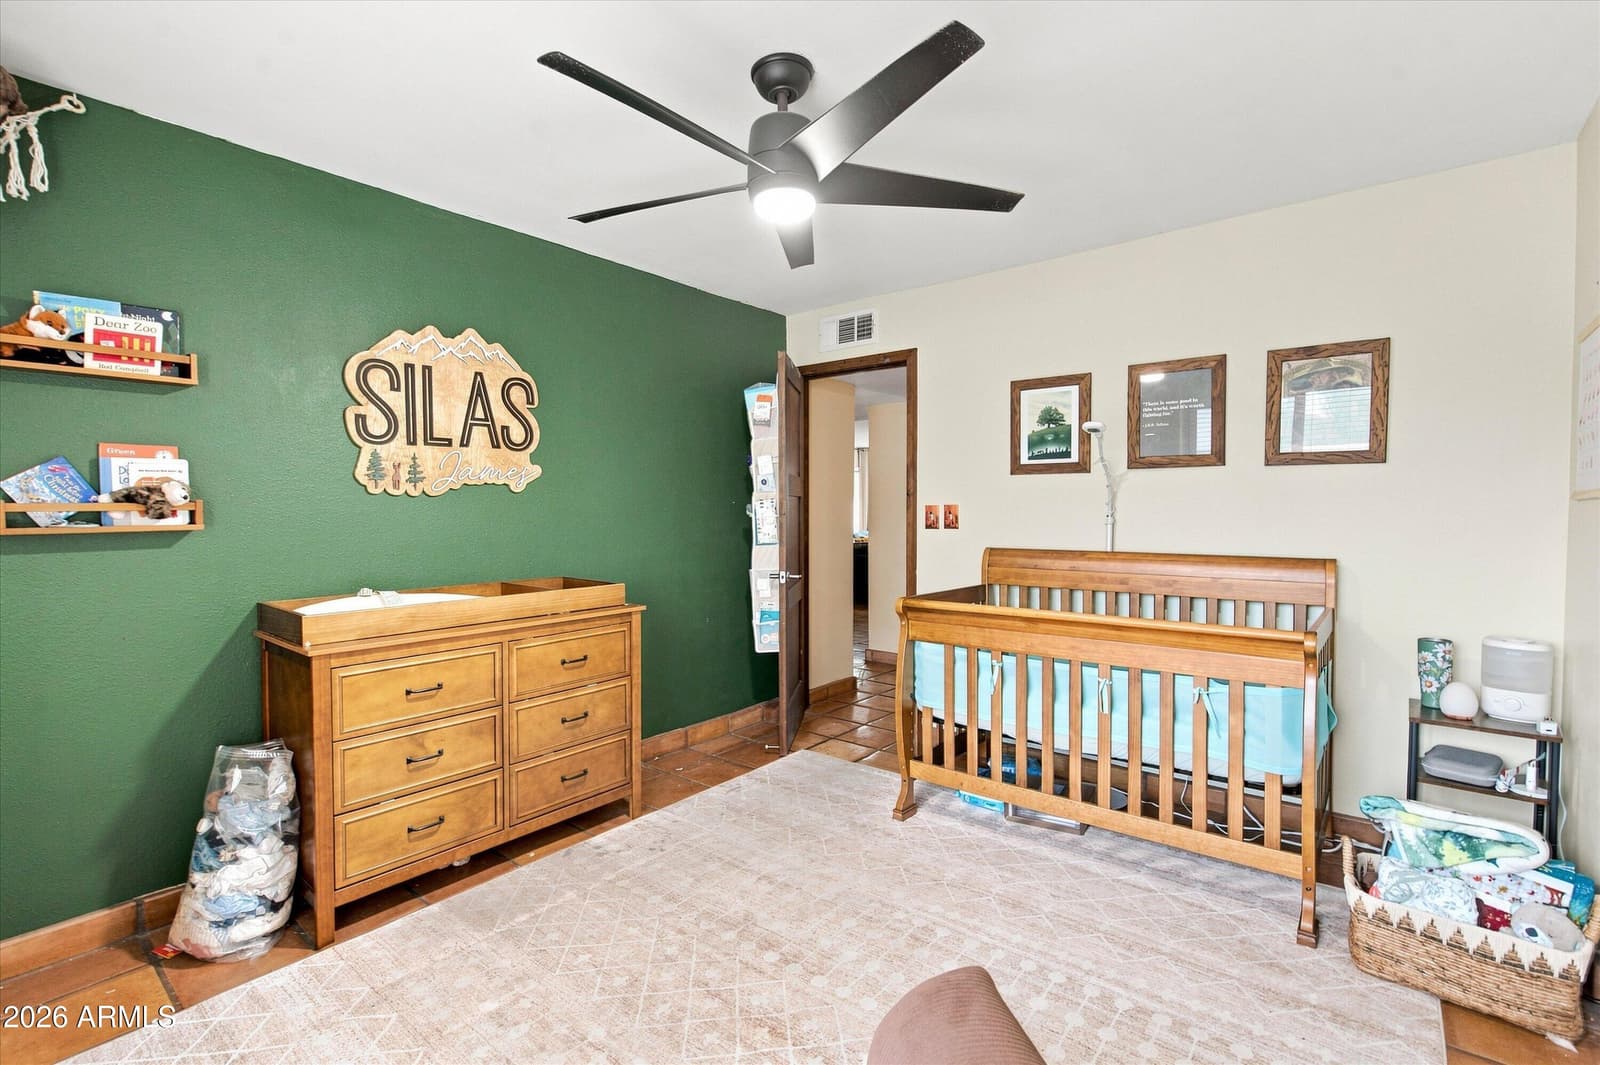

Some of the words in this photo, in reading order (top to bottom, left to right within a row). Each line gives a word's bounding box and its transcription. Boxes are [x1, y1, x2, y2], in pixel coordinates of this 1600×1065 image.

[94, 316, 130, 330] Dear
[134, 321, 157, 334] Zoo
[354, 358, 535, 452] SILAS
[431, 450, 539, 492] James
